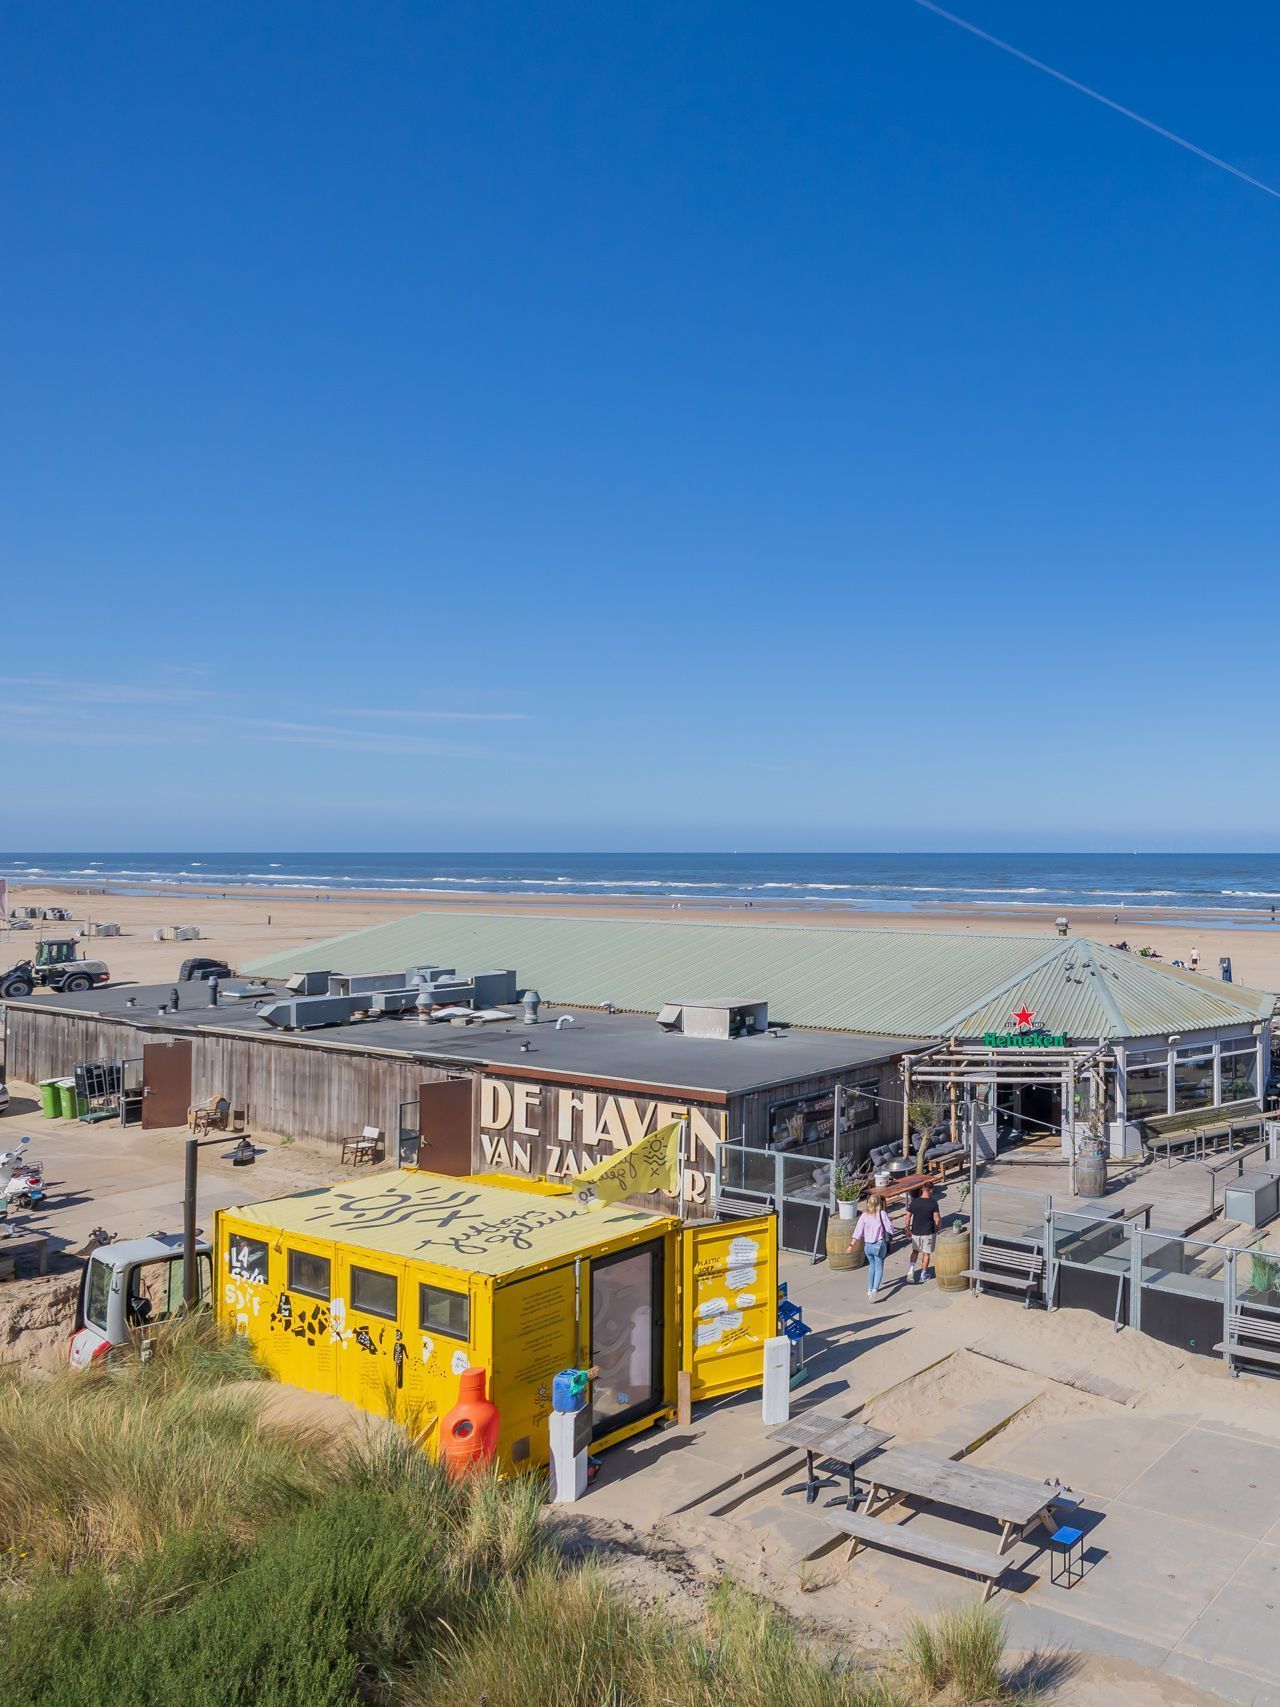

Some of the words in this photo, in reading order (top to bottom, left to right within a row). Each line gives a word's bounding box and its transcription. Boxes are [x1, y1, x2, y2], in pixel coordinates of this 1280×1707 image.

[984, 1031, 1064, 1048] Heineken
[480, 1078, 541, 1138] DE
[480, 1133, 532, 1174] VAN
